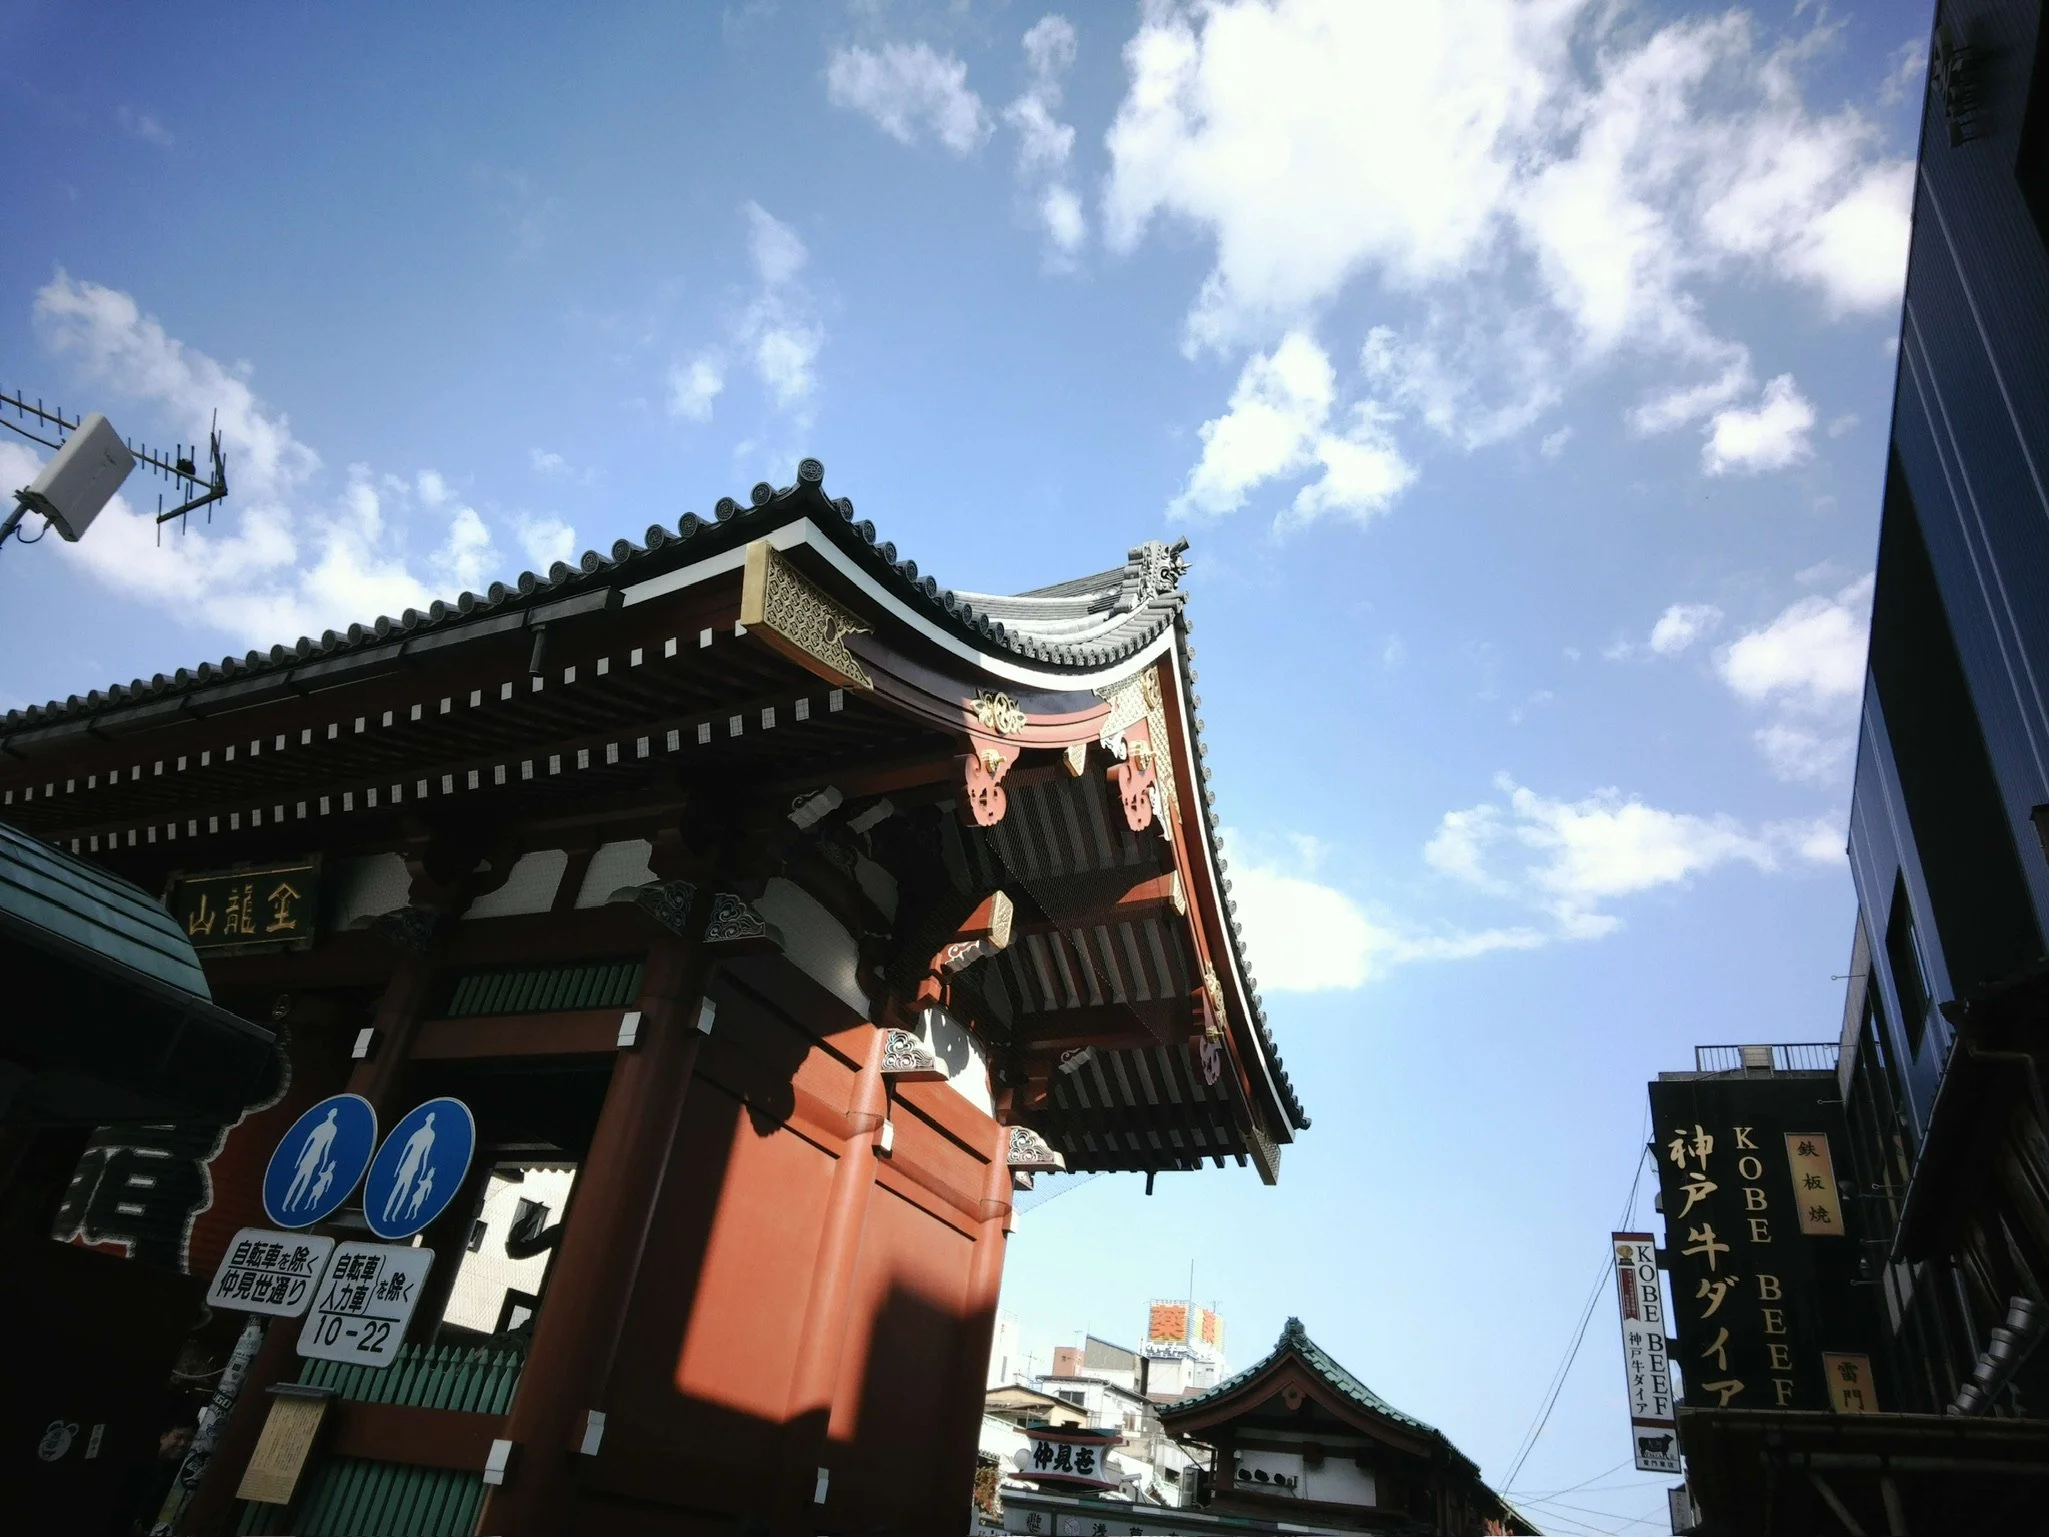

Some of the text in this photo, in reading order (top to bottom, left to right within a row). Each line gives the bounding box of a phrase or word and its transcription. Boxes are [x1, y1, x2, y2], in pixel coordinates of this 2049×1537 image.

[1797, 1141, 1831, 1224] 鉄板焼
[231, 1239, 320, 1275] 自転車を除く
[332, 1252, 381, 1284] 自転車
[1667, 1124, 1745, 1408] 神戸牛ダイア
[1733, 1127, 1794, 1407] KOBE BEEF
[216, 1269, 307, 1306] 仲見世通り
[319, 1280, 370, 1313] 人力車
[375, 1272, 414, 1303] を除く
[1150, 1305, 1185, 1340] 薬
[1635, 1245, 1669, 1416] KOBE BEEF
[1628, 1331, 1648, 1414] 神戸牛ダイア
[1836, 1361, 1865, 1410] 雷門
[1033, 1440, 1096, 1475] 仲見世
